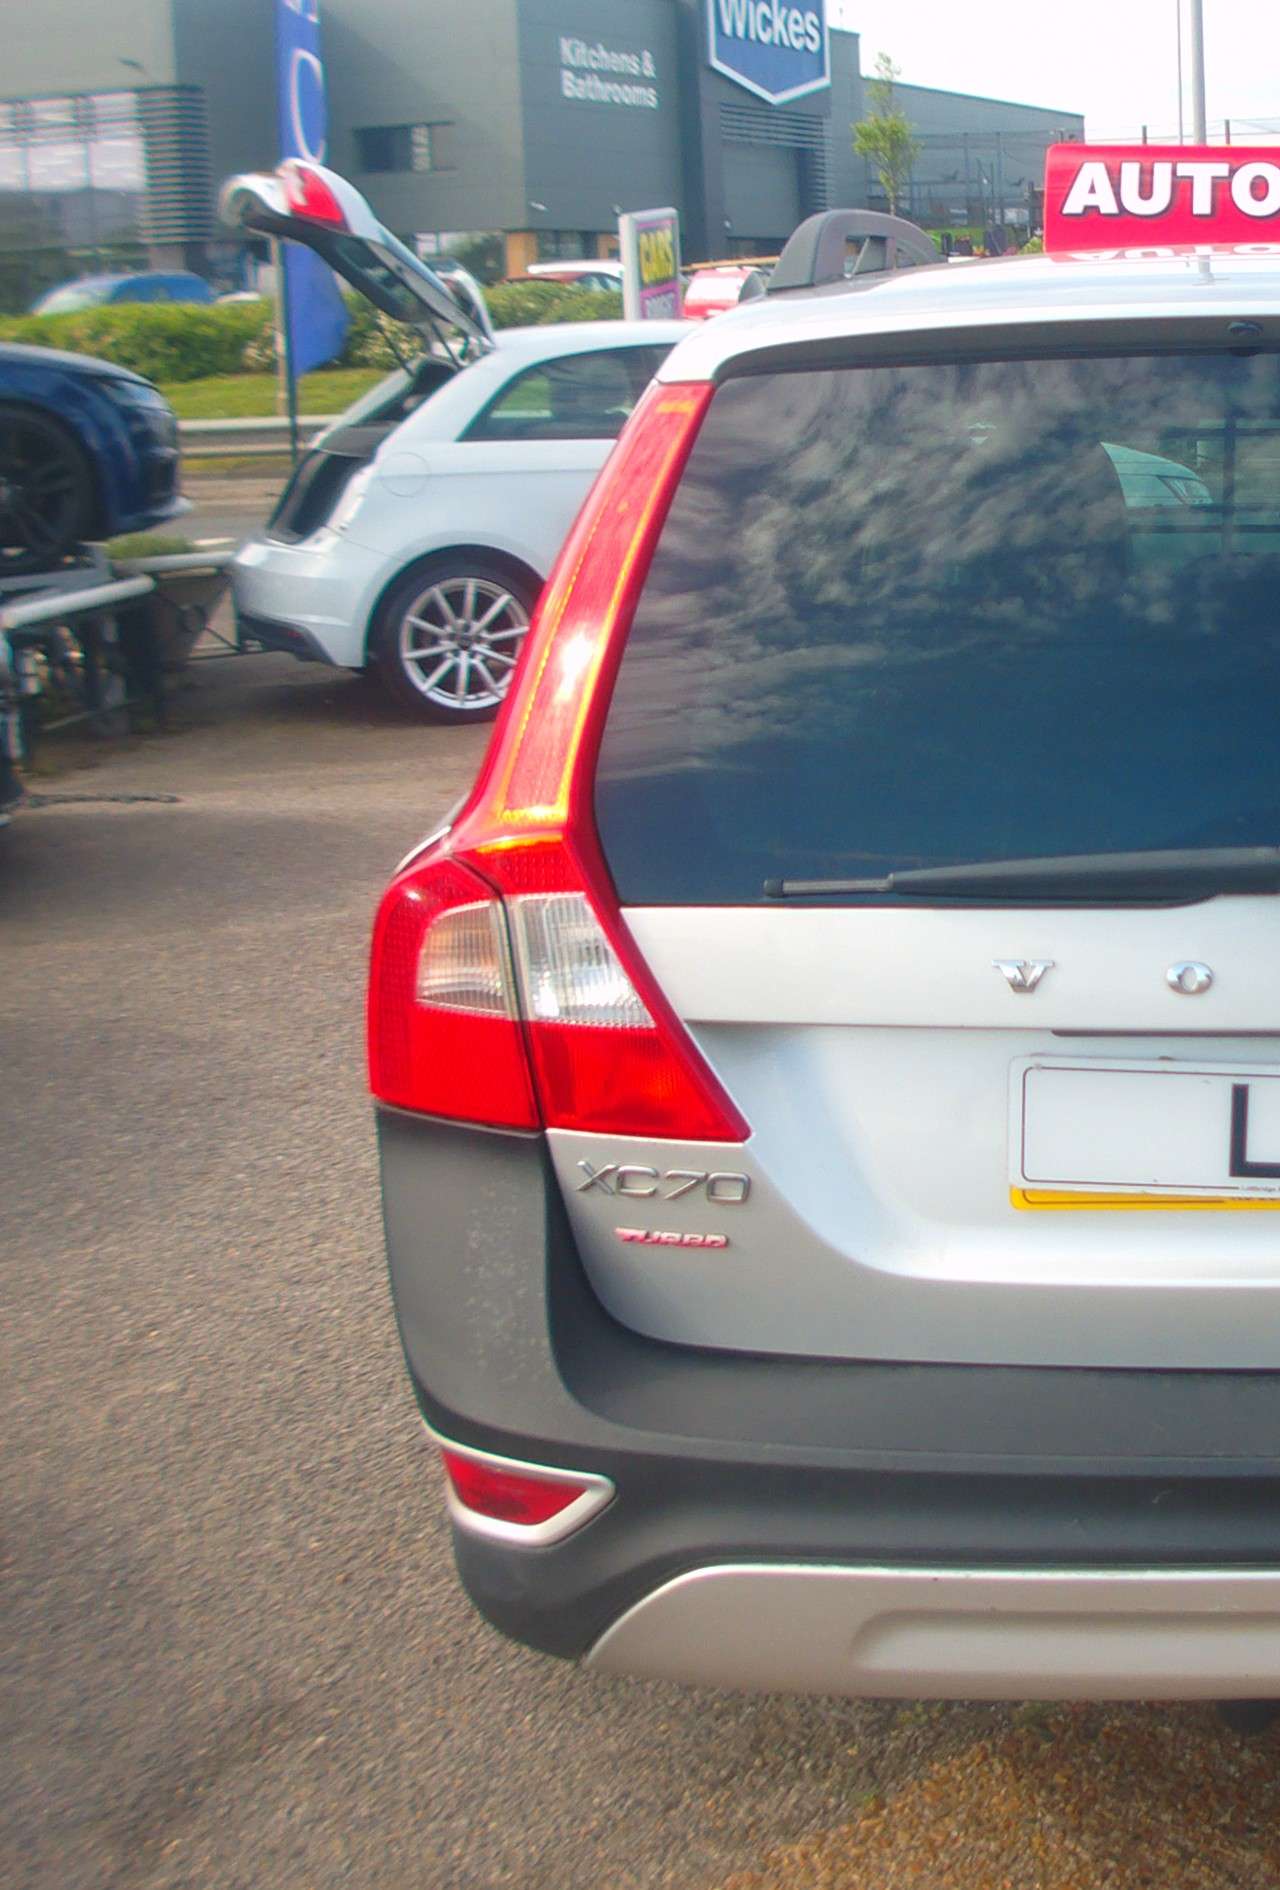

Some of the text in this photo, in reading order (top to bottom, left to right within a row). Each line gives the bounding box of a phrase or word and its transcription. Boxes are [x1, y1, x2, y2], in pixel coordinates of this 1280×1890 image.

[719, 0, 820, 52] Wickes
[560, 37, 656, 78] Kitchens &
[561, 70, 657, 108] Bathrooms
[576, 1160, 752, 1203] XC70
[615, 1227, 729, 1248] TURBO
